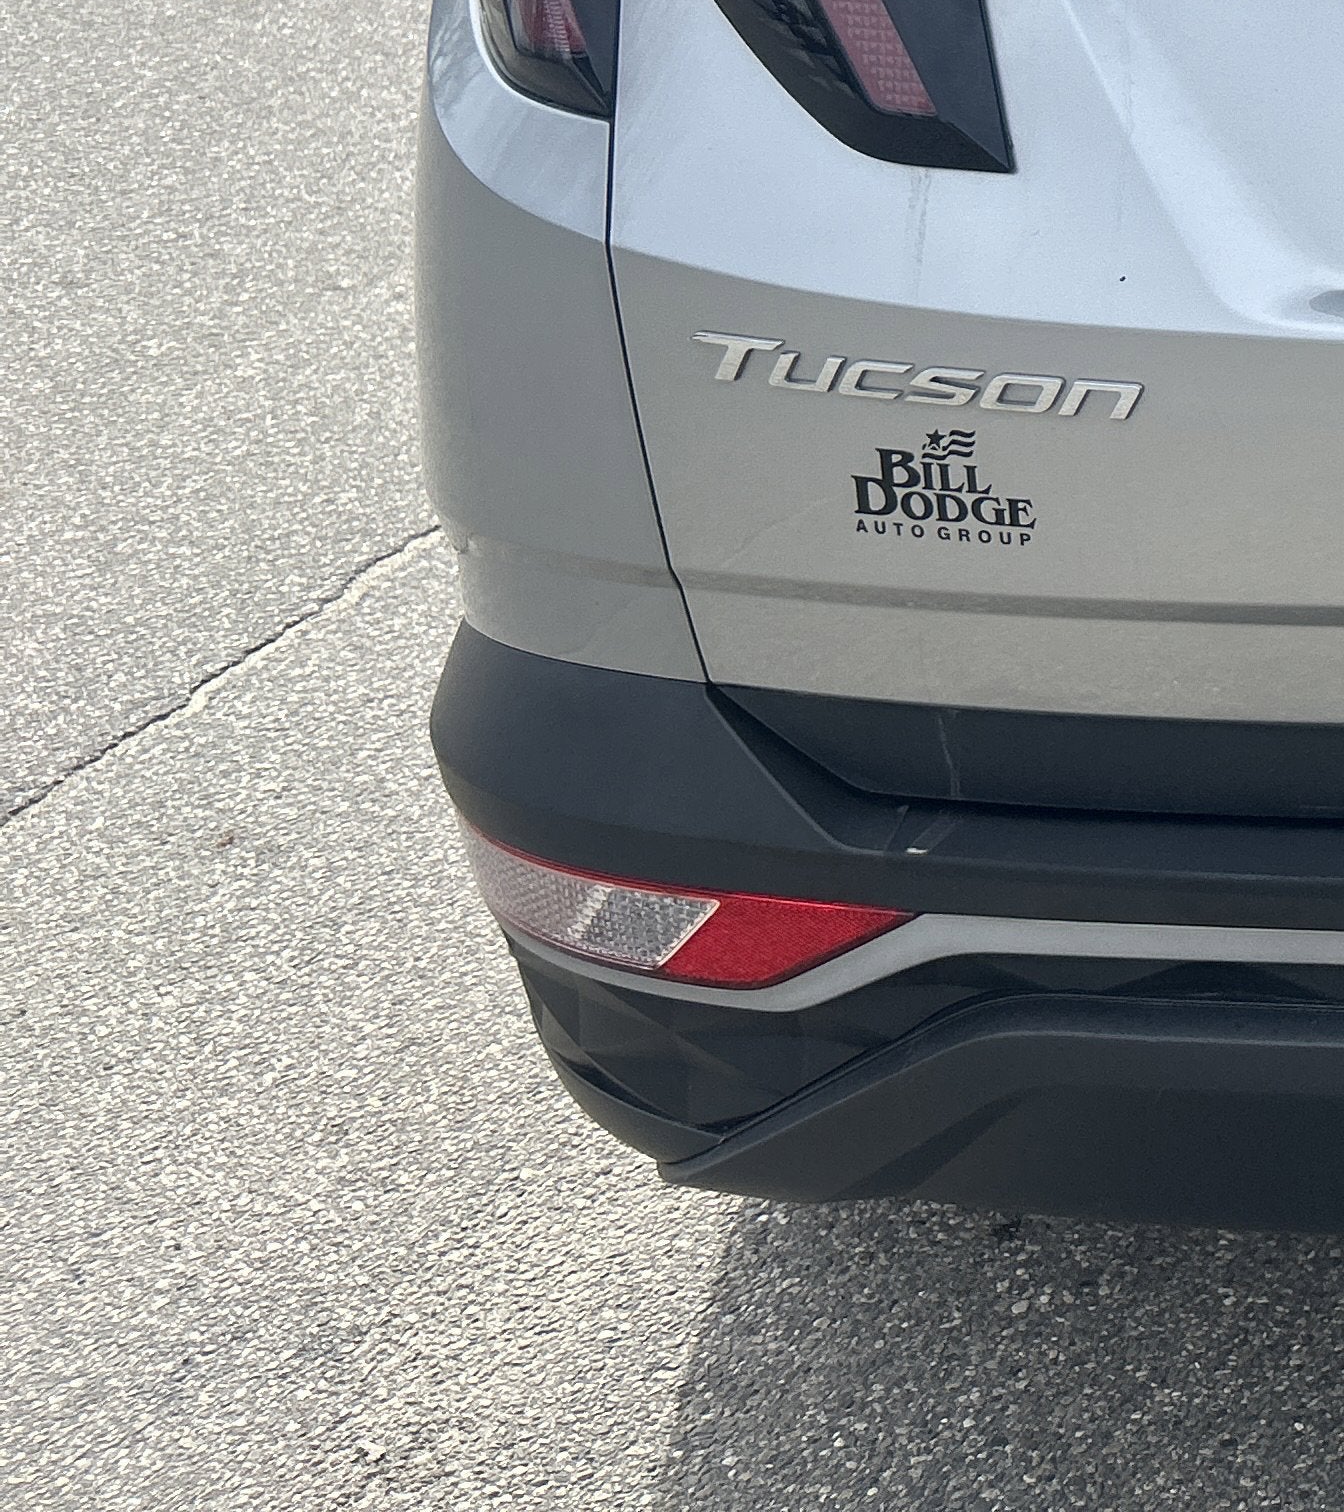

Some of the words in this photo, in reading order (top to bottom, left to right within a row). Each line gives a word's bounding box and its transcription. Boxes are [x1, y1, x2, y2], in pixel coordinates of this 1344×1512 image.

[875, 447, 993, 495] BILL
[850, 474, 1037, 530] DODGE
[856, 518, 926, 539] AUTO
[936, 526, 1032, 546] GROUP
